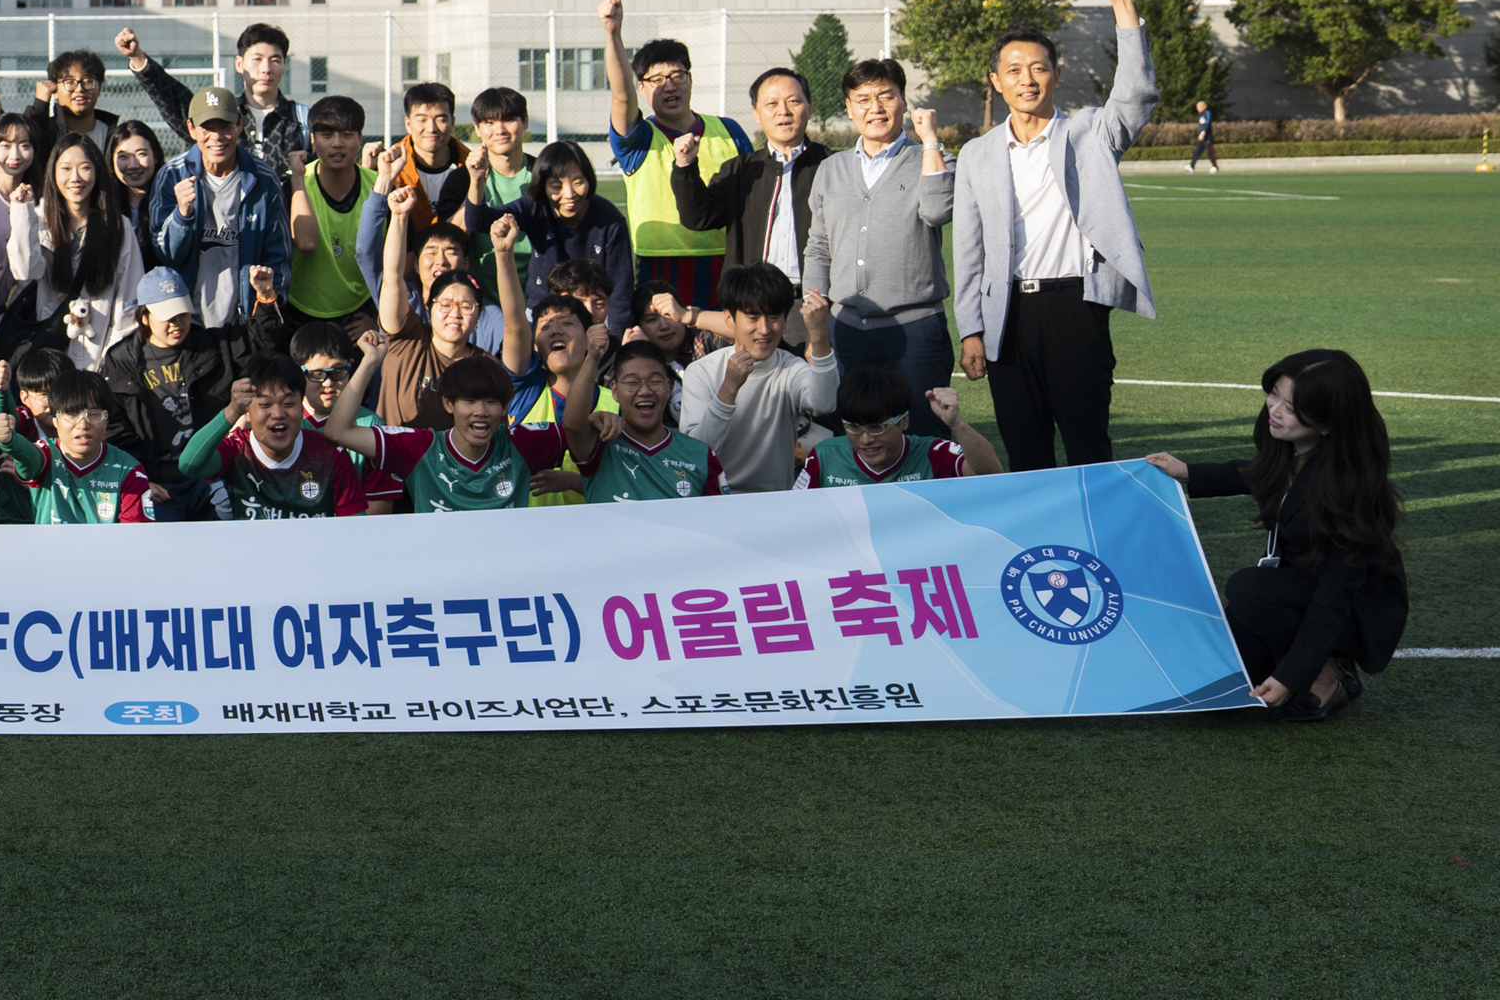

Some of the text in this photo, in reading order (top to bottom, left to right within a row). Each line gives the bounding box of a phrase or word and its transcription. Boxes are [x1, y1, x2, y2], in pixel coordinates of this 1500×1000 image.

[206, 91, 219, 107] LA
[1006, 547, 1101, 578] 배재대학교
[273, 593, 581, 670] 여자축구단)
[602, 580, 815, 662] 어울림
[828, 564, 980, 646] 축제
[1008, 591, 1120, 642] PAI CHAI UNIVERSITY
[121, 703, 184, 724] 주최
[222, 682, 925, 723] 배재대학교 라이즈사업단, 스포츠문화진흥원
